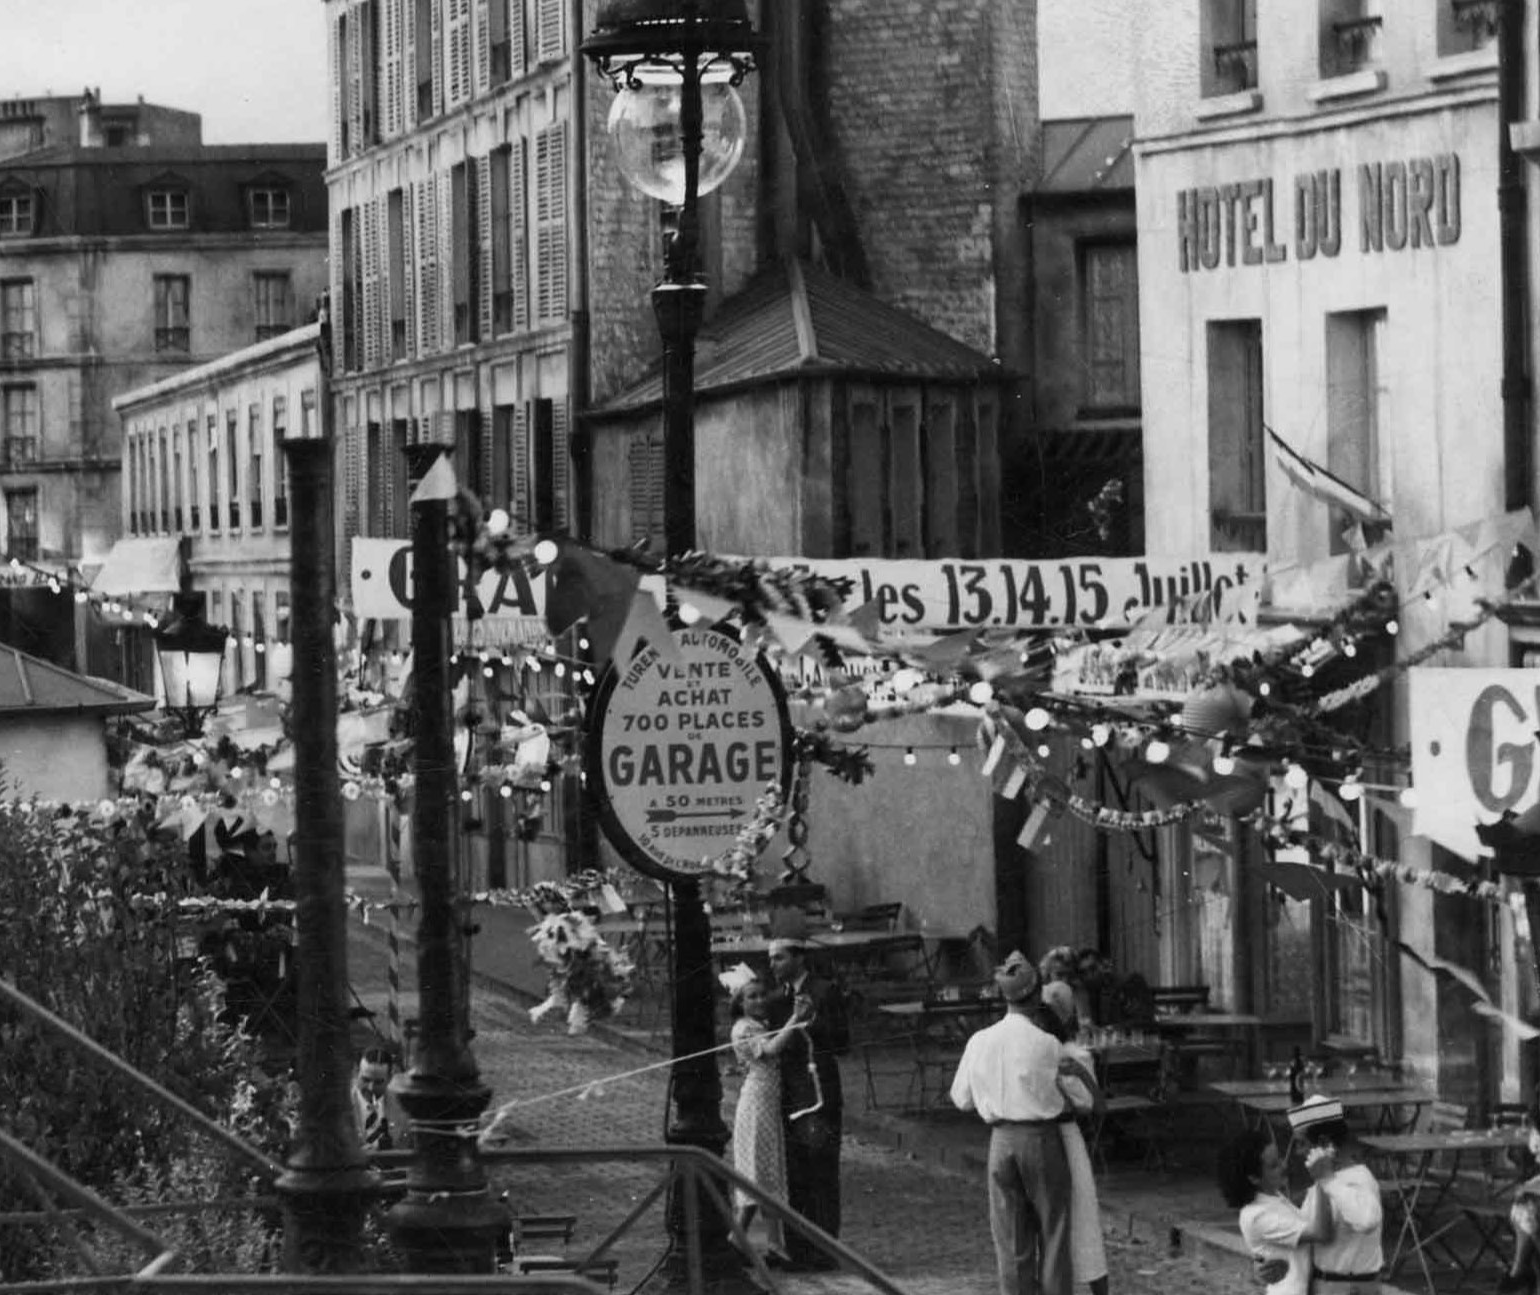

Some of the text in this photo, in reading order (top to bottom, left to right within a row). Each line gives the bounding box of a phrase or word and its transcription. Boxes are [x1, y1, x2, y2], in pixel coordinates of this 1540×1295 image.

[1176, 151, 1461, 273] HOTEL DU NORD
[941, 563, 1109, 625] 13.14.15
[657, 661, 731, 679] VENTE
[657, 689, 732, 706] ACHAT
[622, 710, 766, 732] 700 PLACES
[609, 740, 777, 787] GARAGE
[649, 799, 658, 808] A
[666, 794, 690, 808] 50
[650, 824, 660, 838] 5
